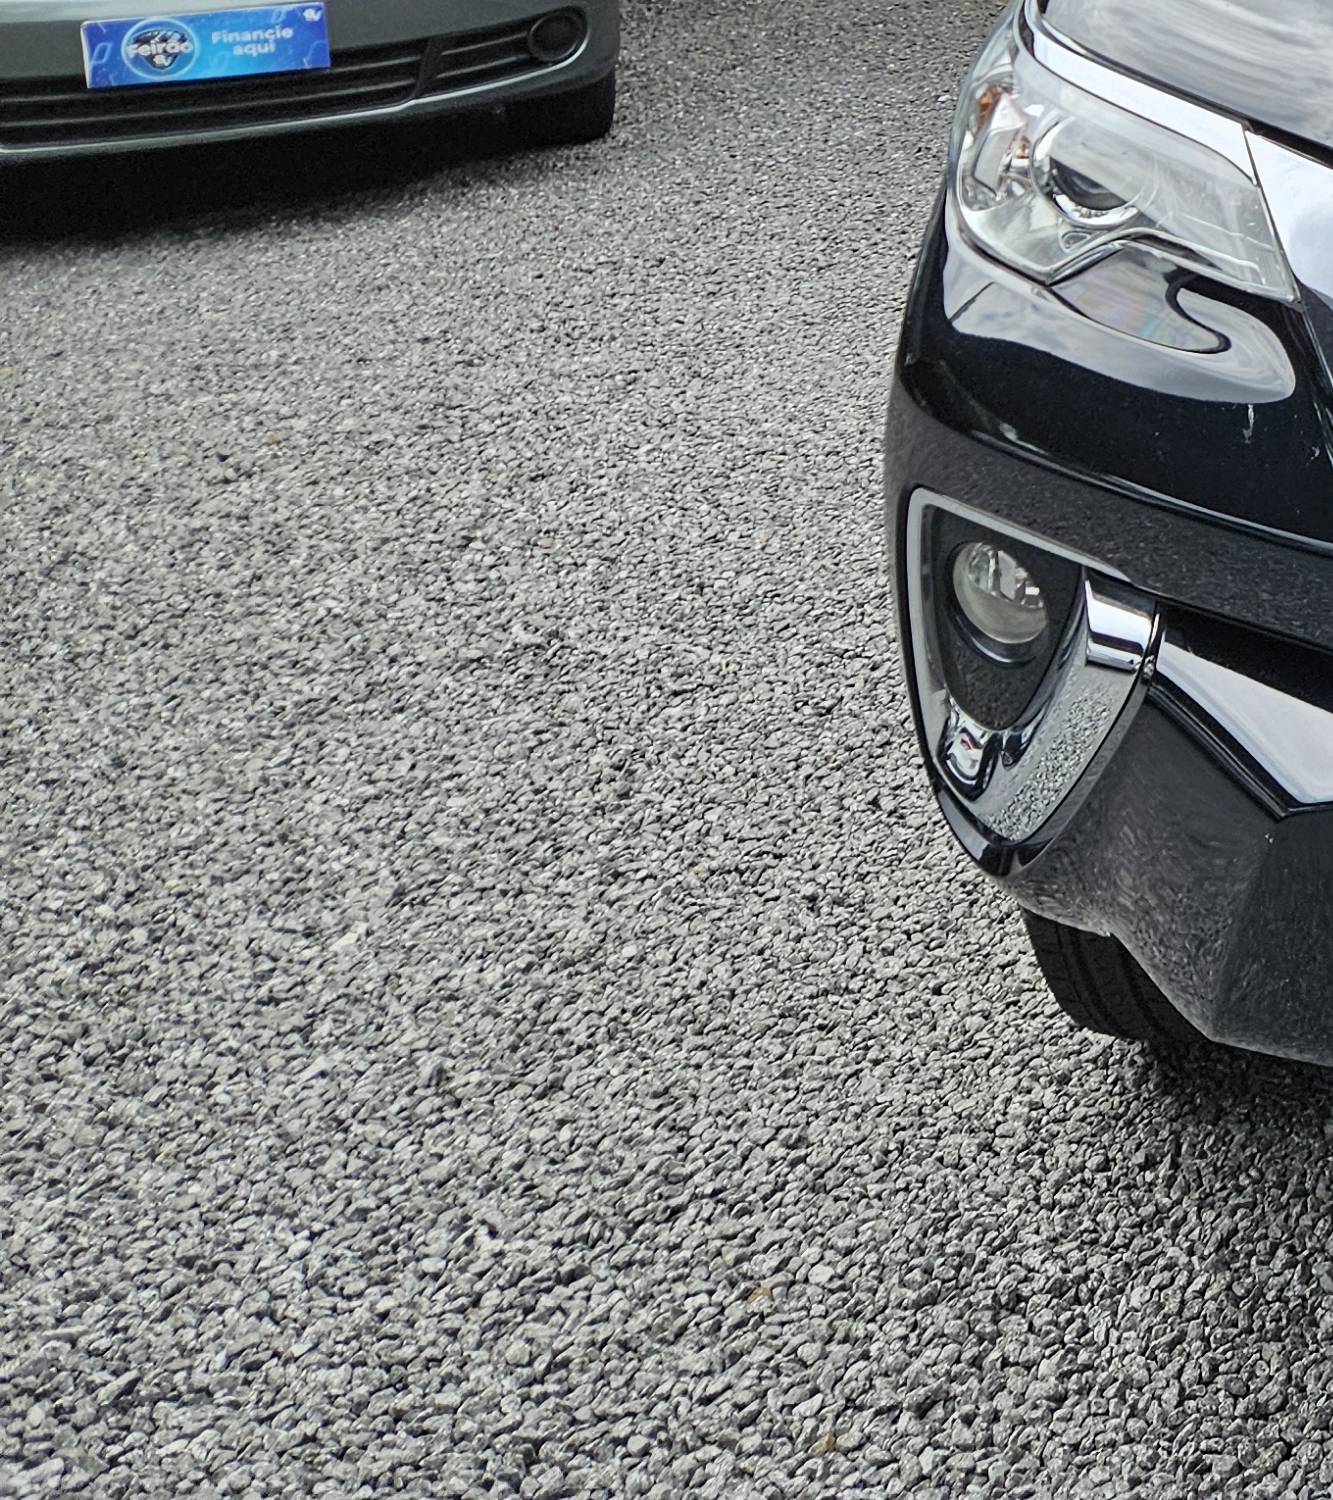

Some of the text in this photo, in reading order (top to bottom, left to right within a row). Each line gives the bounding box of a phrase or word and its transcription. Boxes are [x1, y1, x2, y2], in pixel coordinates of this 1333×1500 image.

[211, 27, 294, 45] Financie
[126, 39, 194, 58] Feirão
[232, 40, 276, 57] aqui
